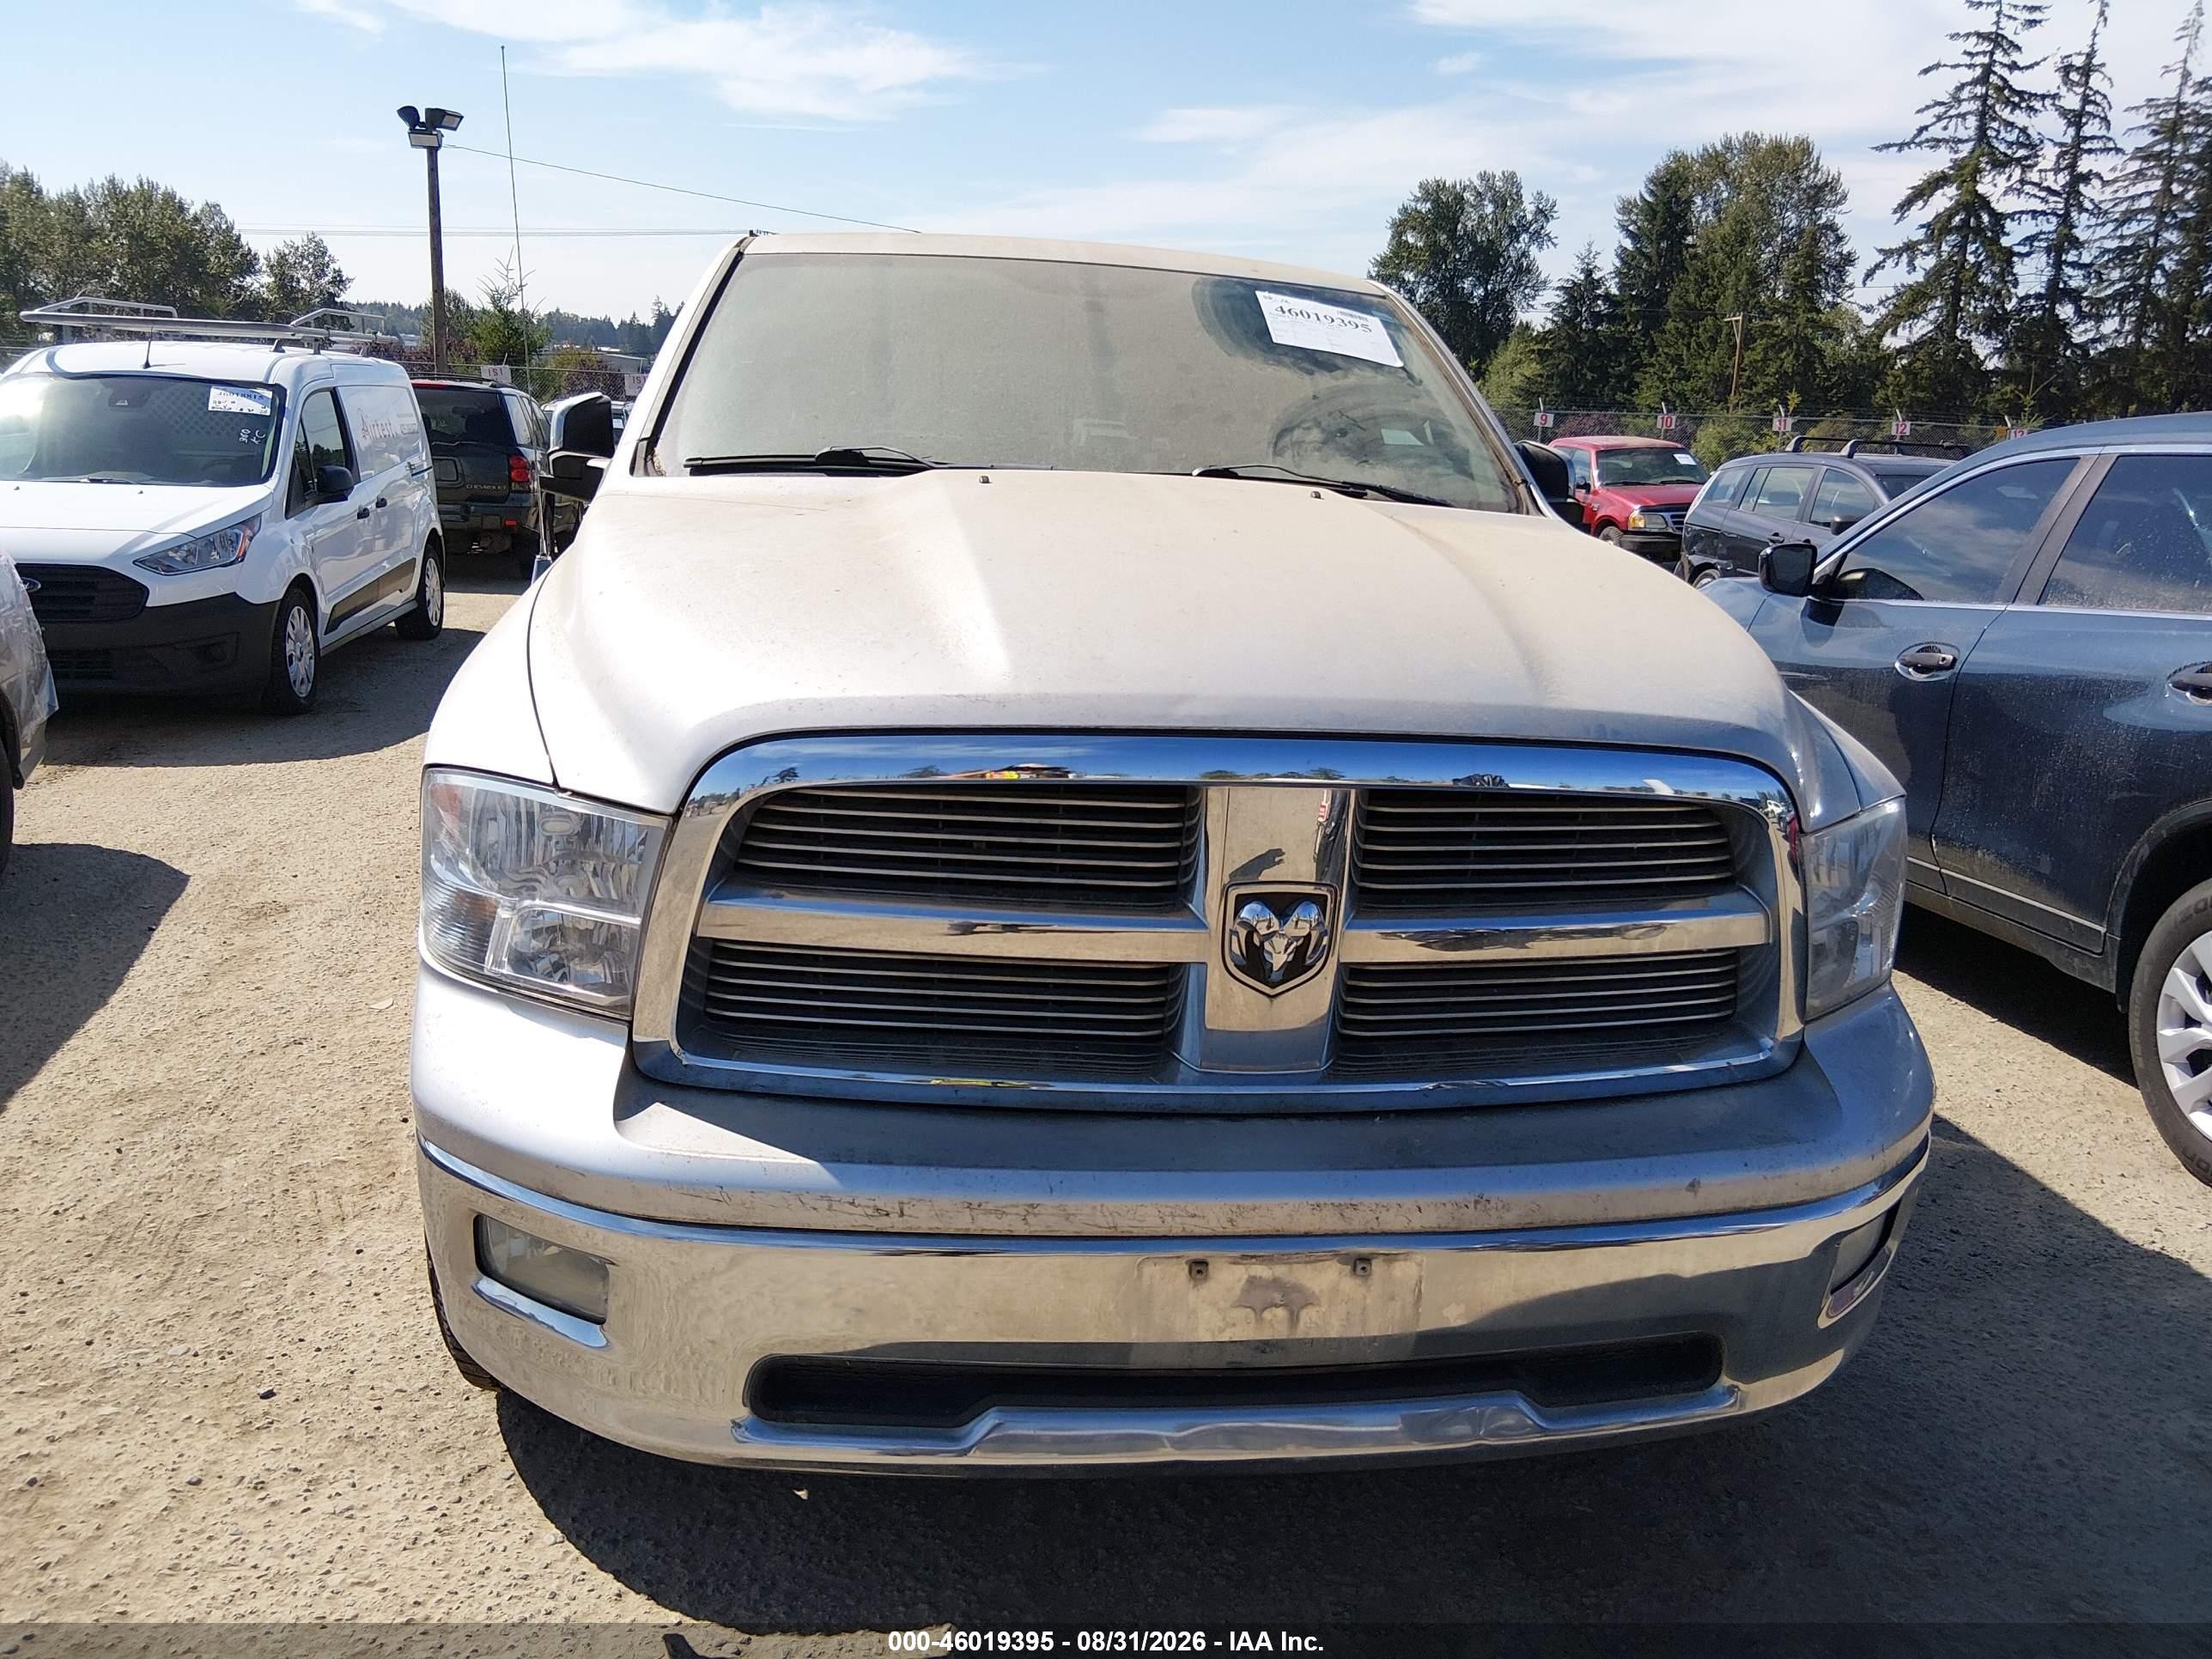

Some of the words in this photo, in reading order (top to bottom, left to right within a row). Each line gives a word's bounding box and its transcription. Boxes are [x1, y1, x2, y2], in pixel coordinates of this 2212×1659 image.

[1274, 305, 1372, 333] 46019395
[1540, 413, 1547, 426] 9
[1661, 416, 1673, 428] 10
[1895, 422, 1907, 434] 12
